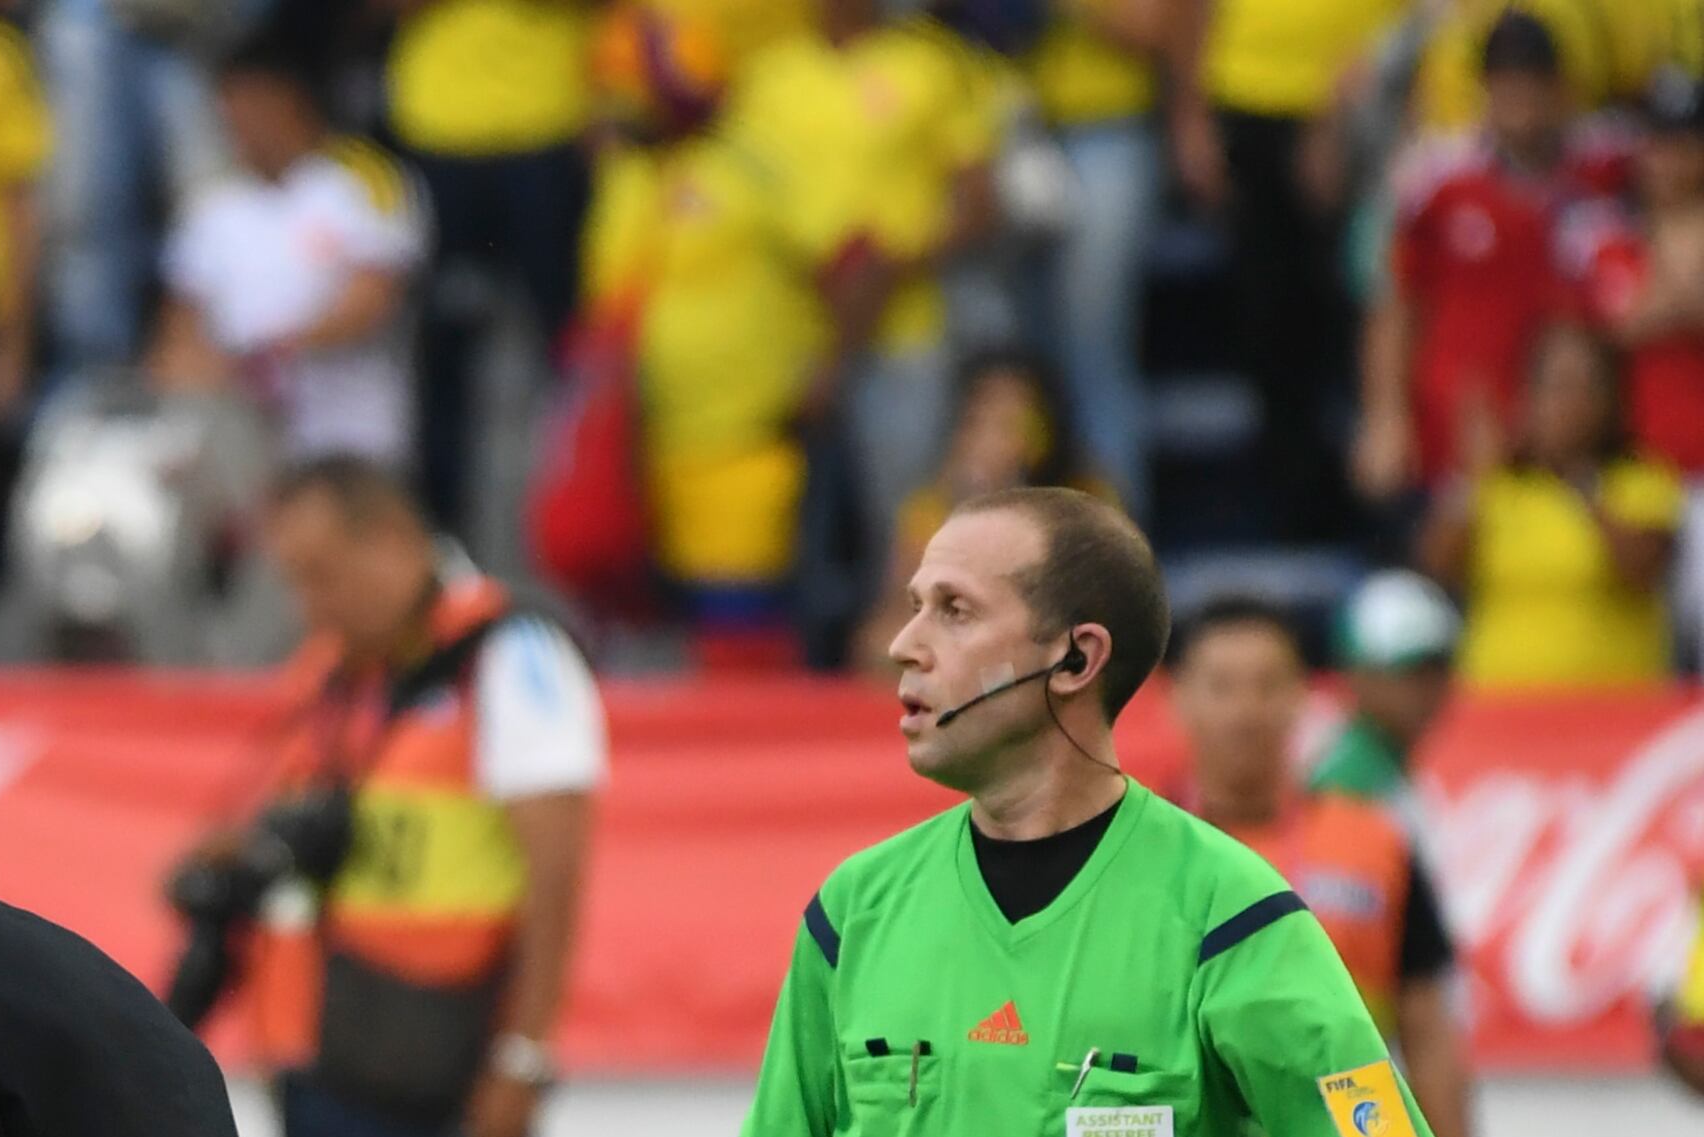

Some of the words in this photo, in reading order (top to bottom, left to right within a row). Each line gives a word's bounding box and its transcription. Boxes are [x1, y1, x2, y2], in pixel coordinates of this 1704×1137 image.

[968, 1028, 1029, 1046] adidas
[1325, 1077, 1358, 1093] FIFA
[1076, 1112, 1164, 1127] ASSISTANT
